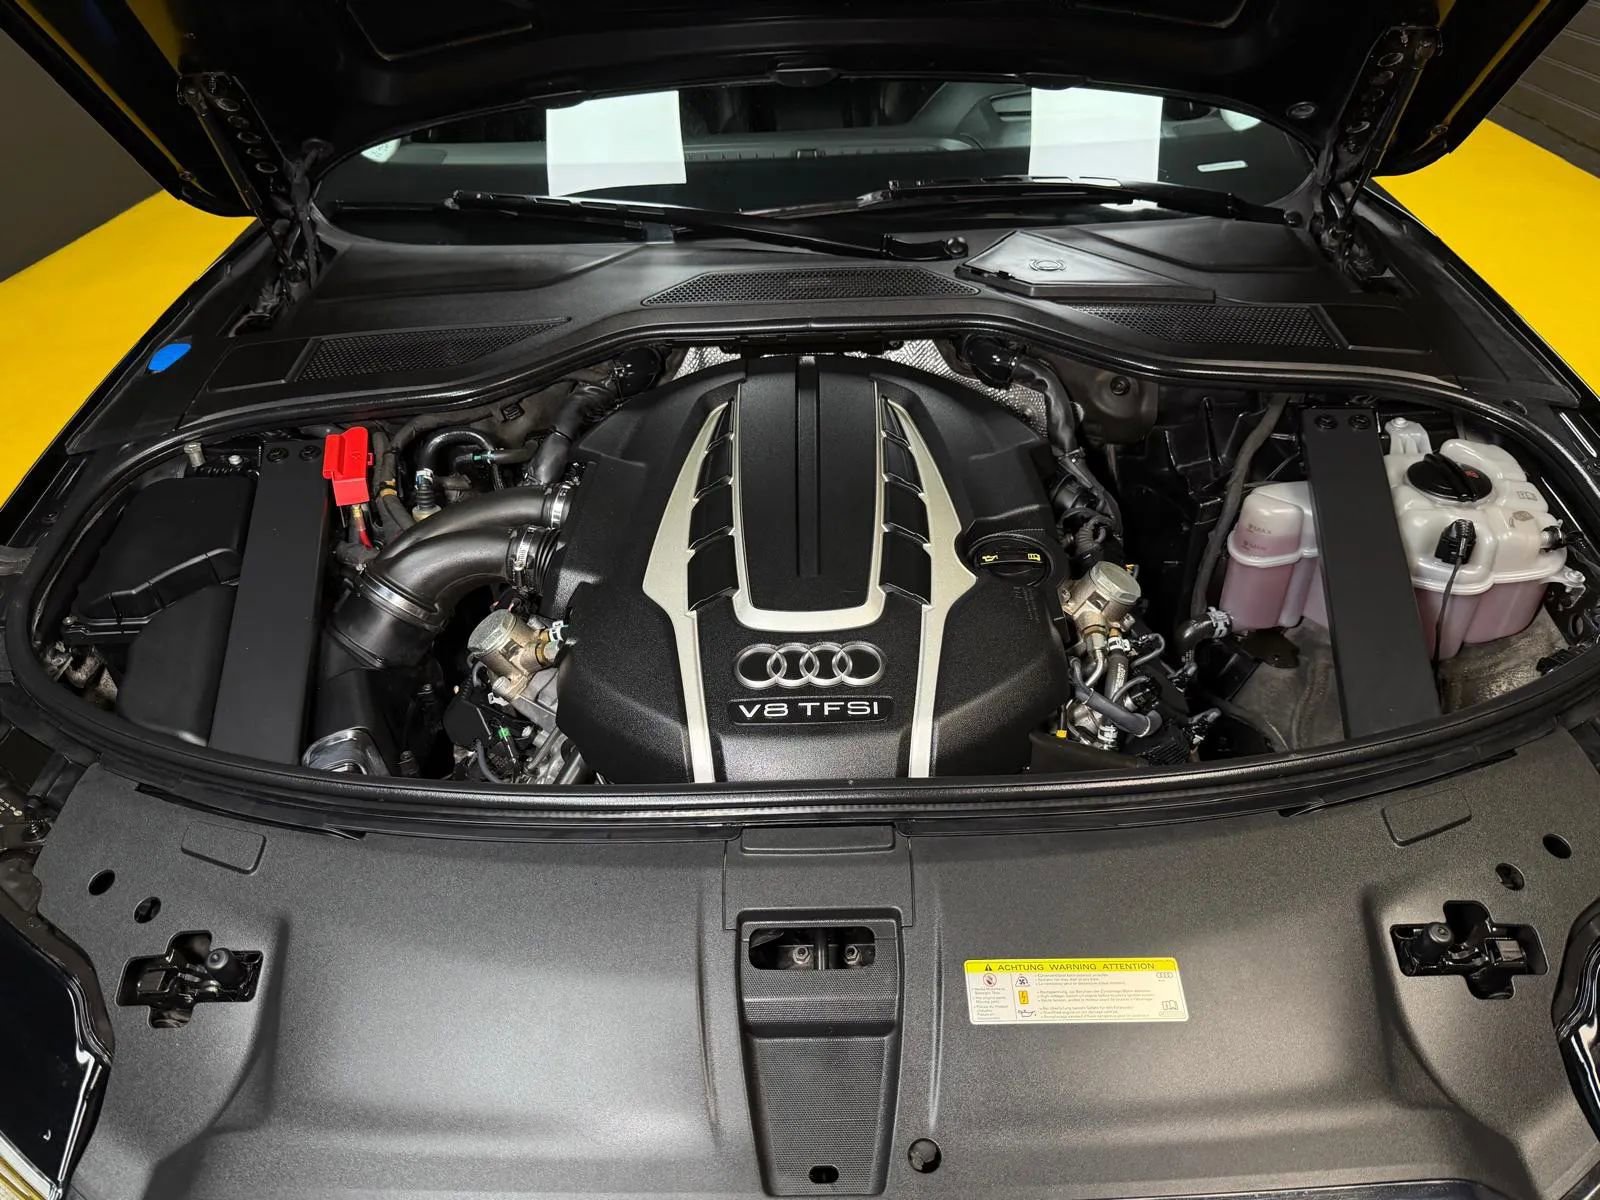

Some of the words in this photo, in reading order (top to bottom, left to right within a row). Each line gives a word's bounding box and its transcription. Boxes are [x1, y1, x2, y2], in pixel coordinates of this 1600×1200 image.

[739, 702, 789, 718] V8
[798, 701, 879, 716] TFSI
[997, 963, 1044, 971] ACHTUNG
[1050, 962, 1097, 971] WARNING
[1102, 962, 1155, 970] ATTENTION
